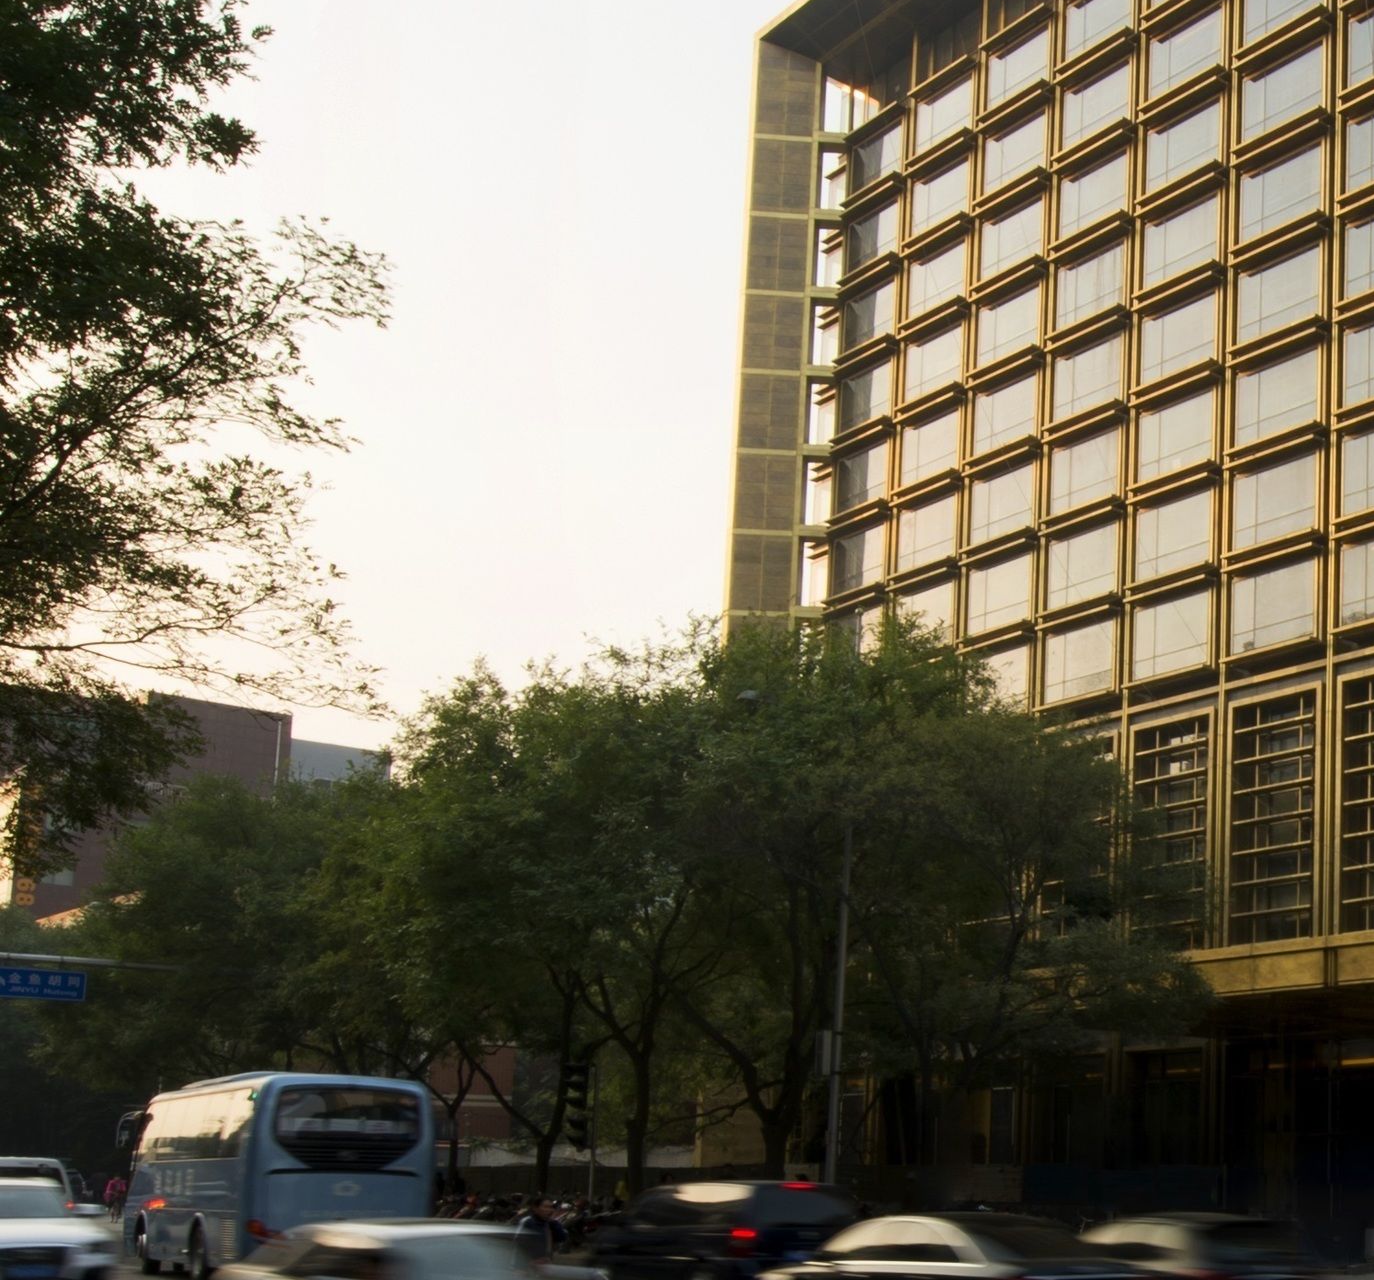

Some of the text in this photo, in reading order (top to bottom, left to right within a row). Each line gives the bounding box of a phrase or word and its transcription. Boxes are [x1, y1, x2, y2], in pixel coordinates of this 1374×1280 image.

[8, 972, 81, 988] 金鱼胡同
[8, 985, 79, 998] JINYU Hutong
